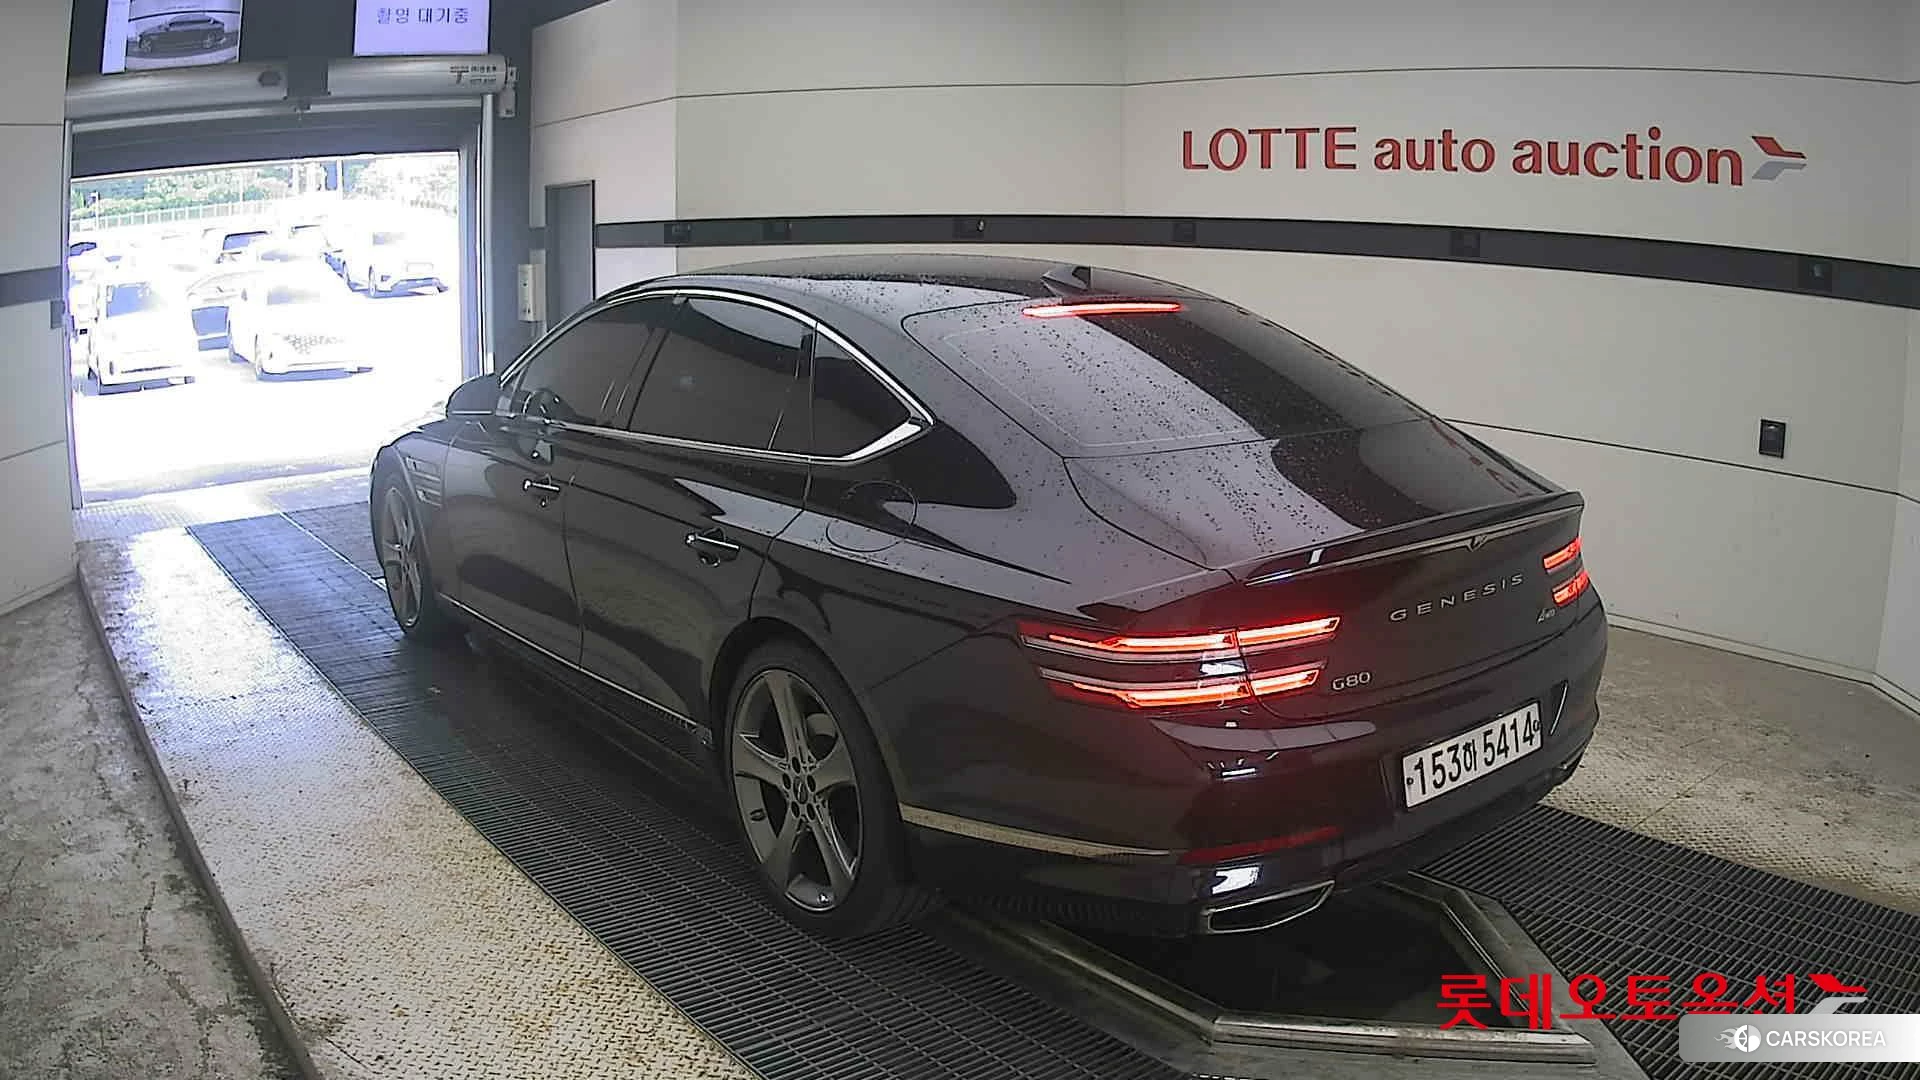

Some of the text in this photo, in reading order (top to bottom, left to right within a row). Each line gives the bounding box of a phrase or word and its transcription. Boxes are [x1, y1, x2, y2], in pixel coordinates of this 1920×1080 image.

[418, 7, 472, 24] 대기중
[1182, 126, 1744, 186] LOTTE auto auction
[1389, 573, 1524, 622] GENESIS
[1332, 671, 1371, 691] G80
[1413, 711, 1534, 796] 153하 5414
